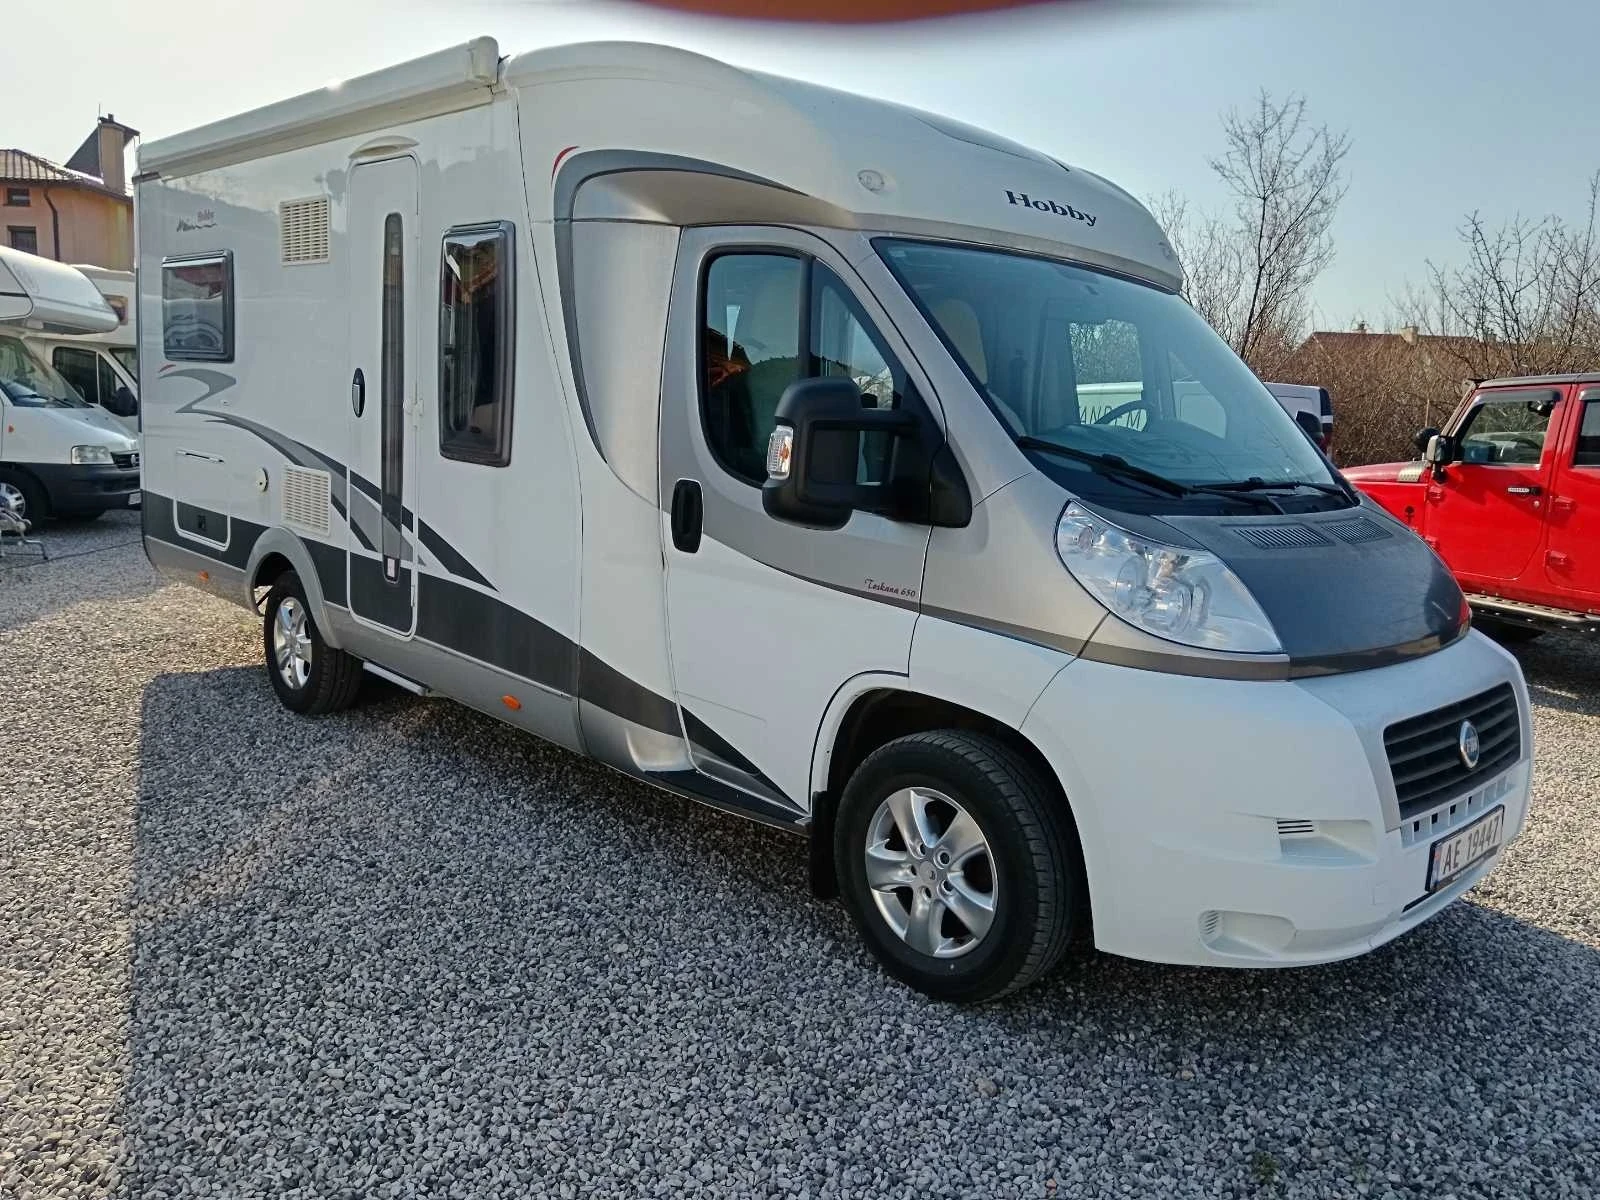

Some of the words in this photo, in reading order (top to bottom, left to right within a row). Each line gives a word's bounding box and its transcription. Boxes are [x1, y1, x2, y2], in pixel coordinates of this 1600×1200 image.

[1004, 189, 1097, 227] Hobby
[901, 587, 916, 597] 650
[1442, 839, 1462, 875] AE
[1467, 815, 1500, 861] 19447
